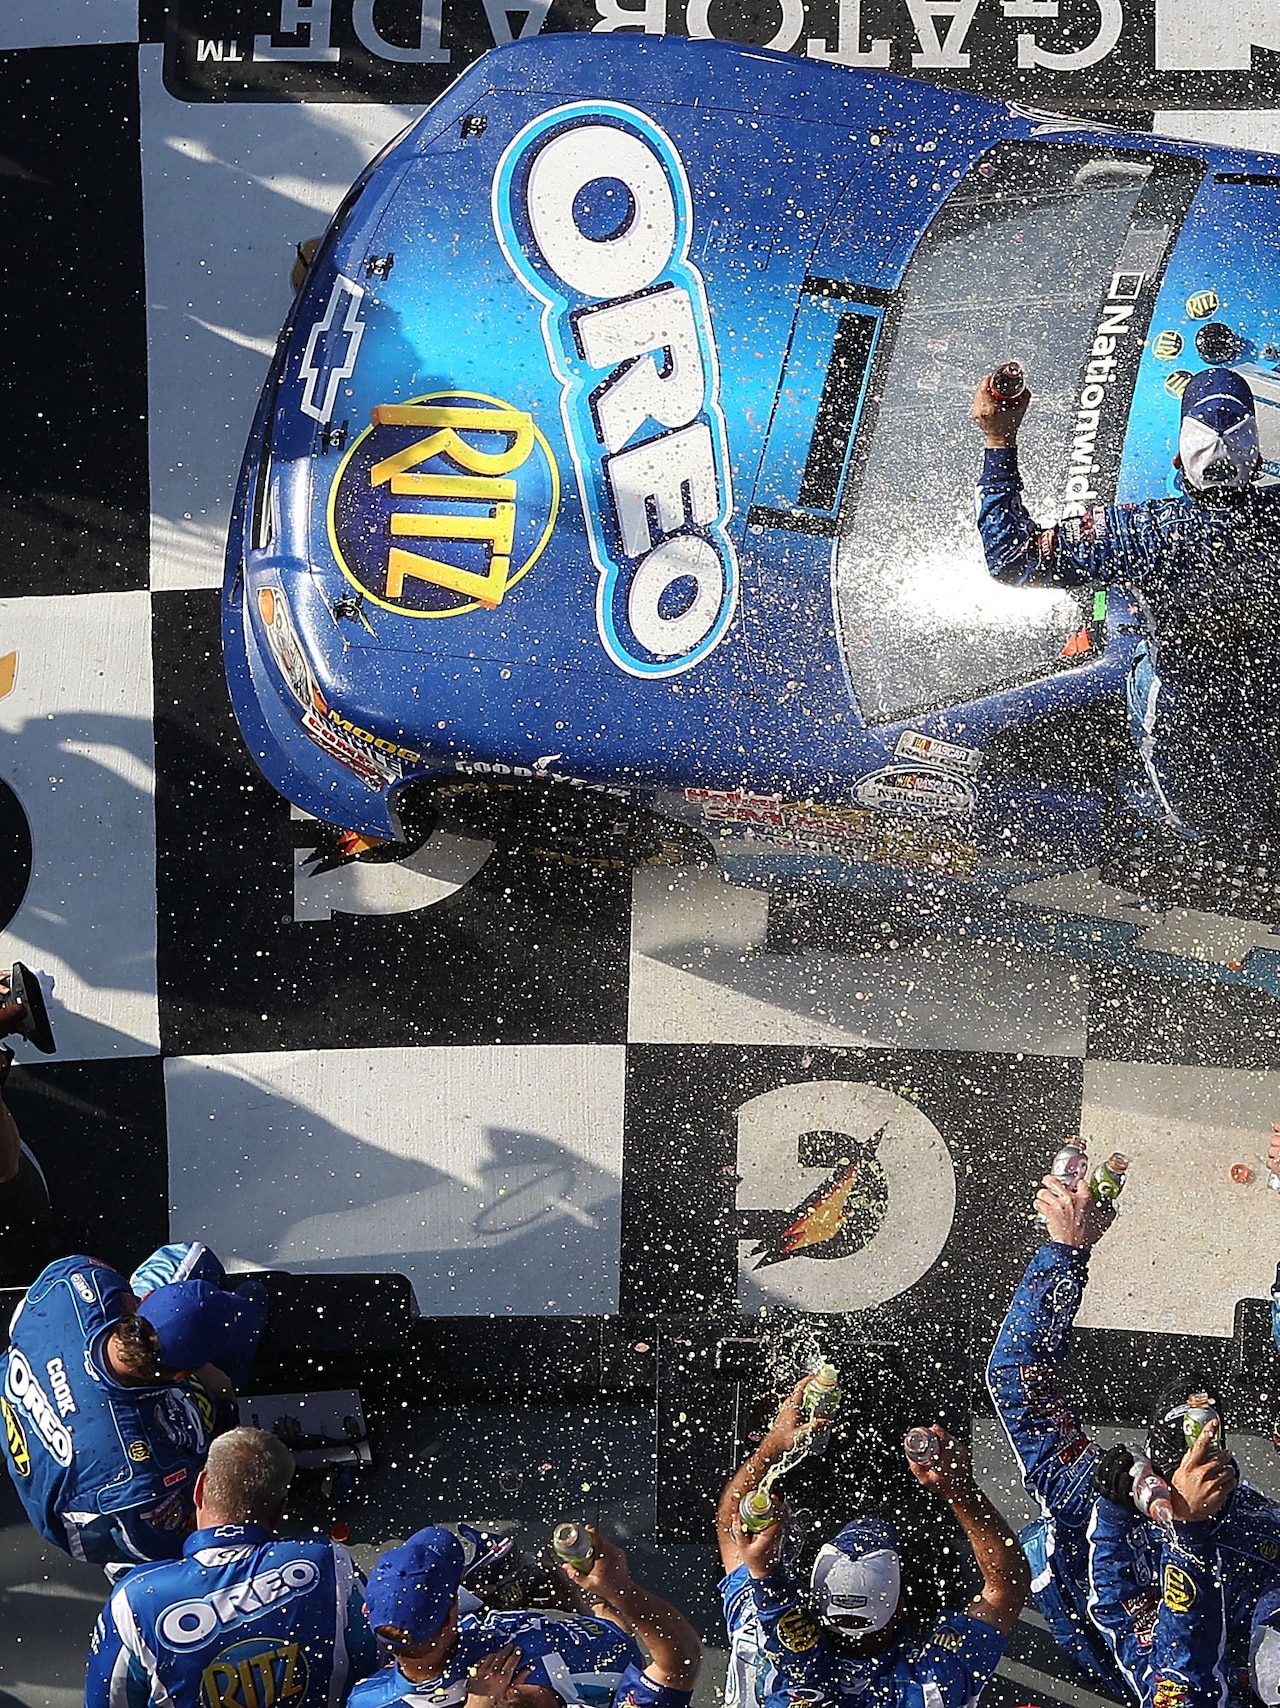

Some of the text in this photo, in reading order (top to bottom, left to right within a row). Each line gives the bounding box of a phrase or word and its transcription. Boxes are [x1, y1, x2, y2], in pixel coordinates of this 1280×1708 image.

[1187, 293, 1217, 317] RITZ
[1154, 331, 1178, 360] RITZ
[522, 122, 726, 656] OREO
[370, 404, 536, 608] RITZ
[328, 709, 421, 764] MOOG
[928, 741, 968, 762] NASCAR
[8, 1354, 72, 1463] OREO
[47, 1357, 77, 1419] COOK
[162, 1564, 316, 1644] OREO
[1164, 1570, 1190, 1614] RITZ
[202, 1641, 304, 1708] RITZ
